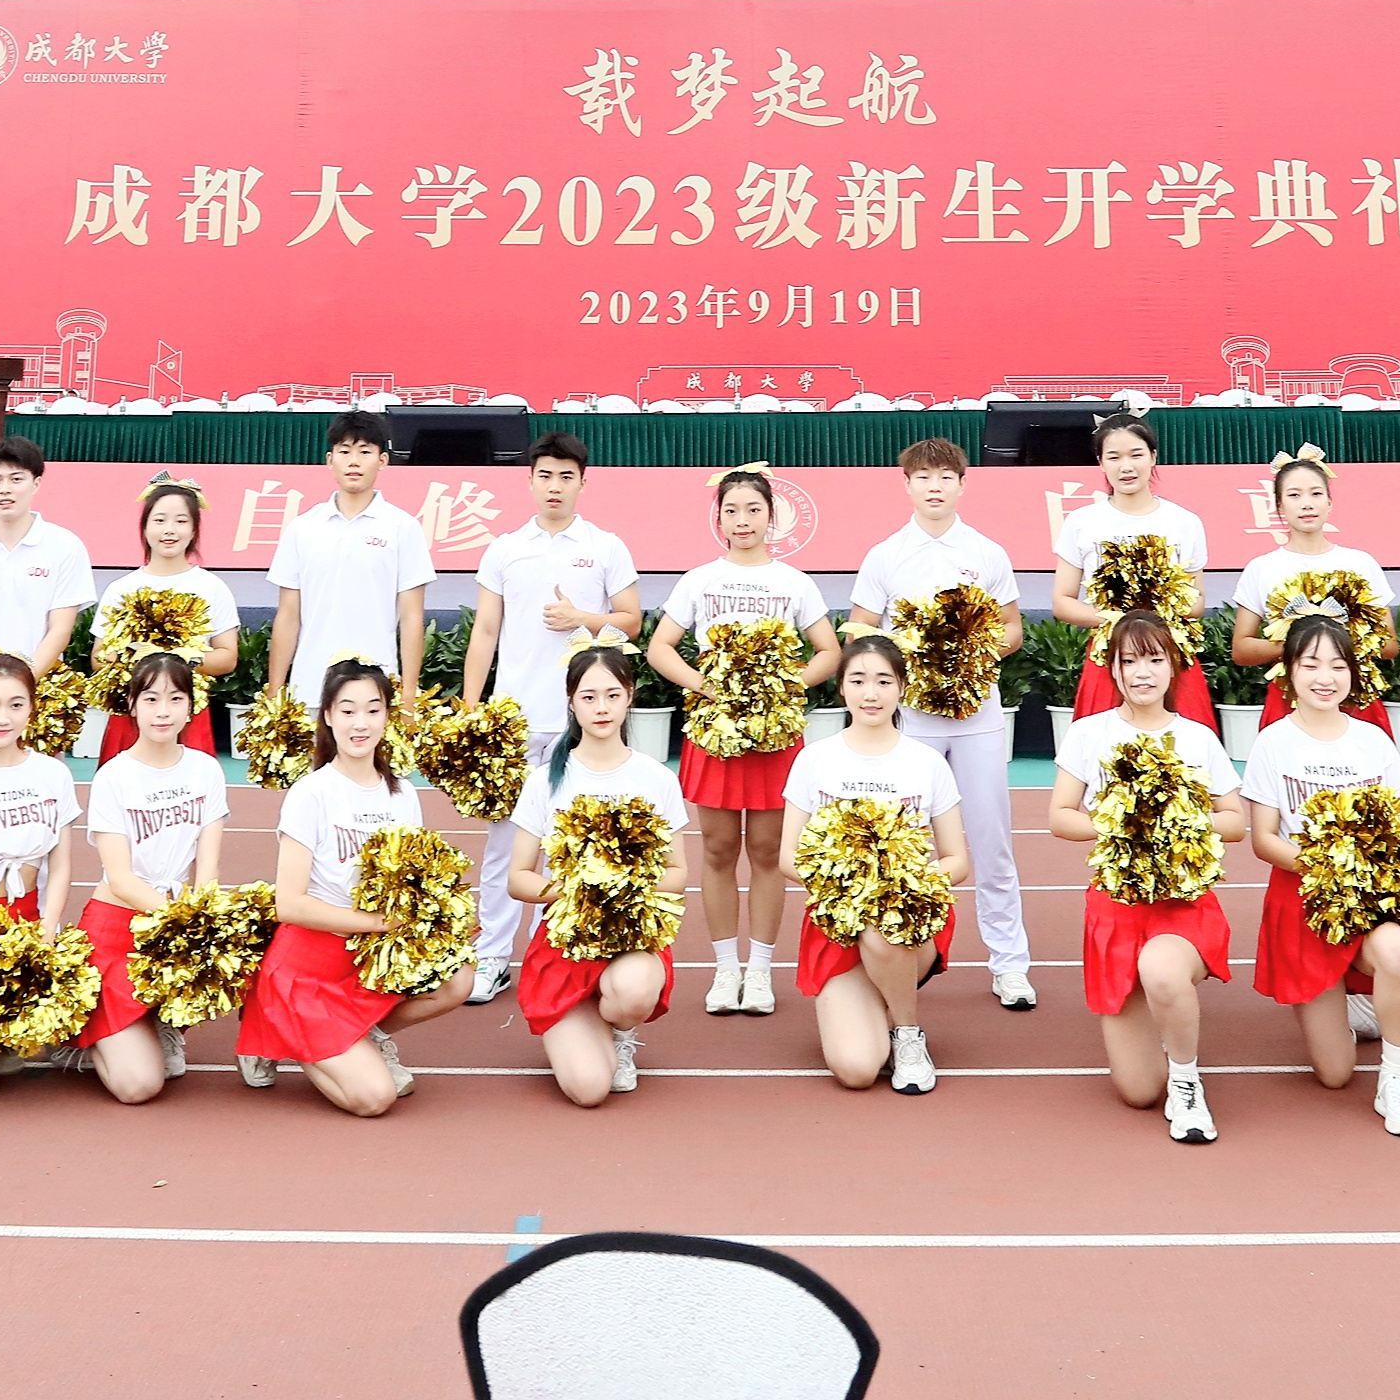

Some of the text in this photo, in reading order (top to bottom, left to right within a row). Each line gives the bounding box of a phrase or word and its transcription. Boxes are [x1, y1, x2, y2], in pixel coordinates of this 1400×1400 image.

[23, 73, 168, 84] CHENGDU UNIVERSITY
[563, 47, 938, 138] 载梦起航
[579, 283, 922, 330] 2023年9月19日
[768, 481, 811, 528] NIVERSITY
[722, 583, 771, 593] NATIONAL
[703, 593, 791, 622] UNIVERSITY
[1303, 765, 1358, 777] NATIONAL
[841, 781, 898, 793] NATIONAL
[352, 812, 397, 825] NATIONAL
